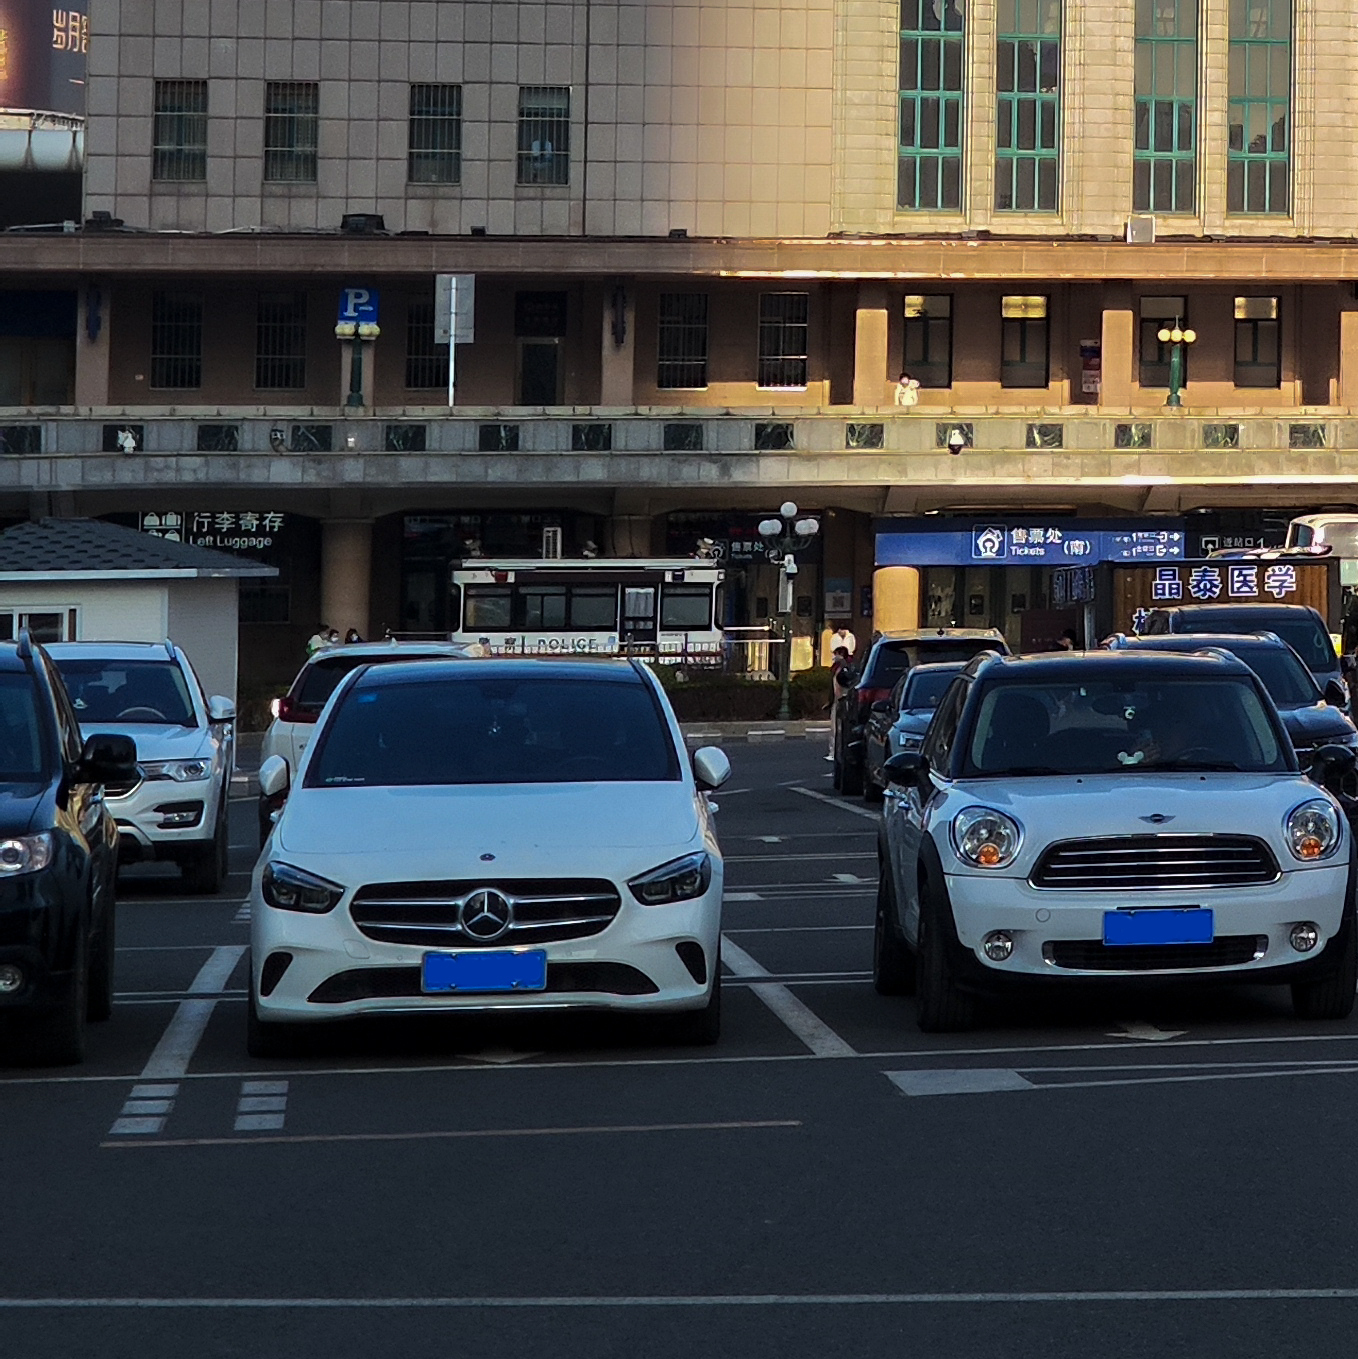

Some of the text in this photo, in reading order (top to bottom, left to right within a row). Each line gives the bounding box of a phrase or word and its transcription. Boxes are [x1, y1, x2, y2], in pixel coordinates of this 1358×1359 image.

[343, 288, 370, 317] P
[192, 511, 285, 533] 行李寄存
[189, 535, 273, 549] Left Luggage
[1010, 527, 1063, 544] 售票处
[1009, 545, 1046, 557] Tickets
[1151, 564, 1298, 600] 晶泰医学
[537, 637, 599, 653] POLICE
